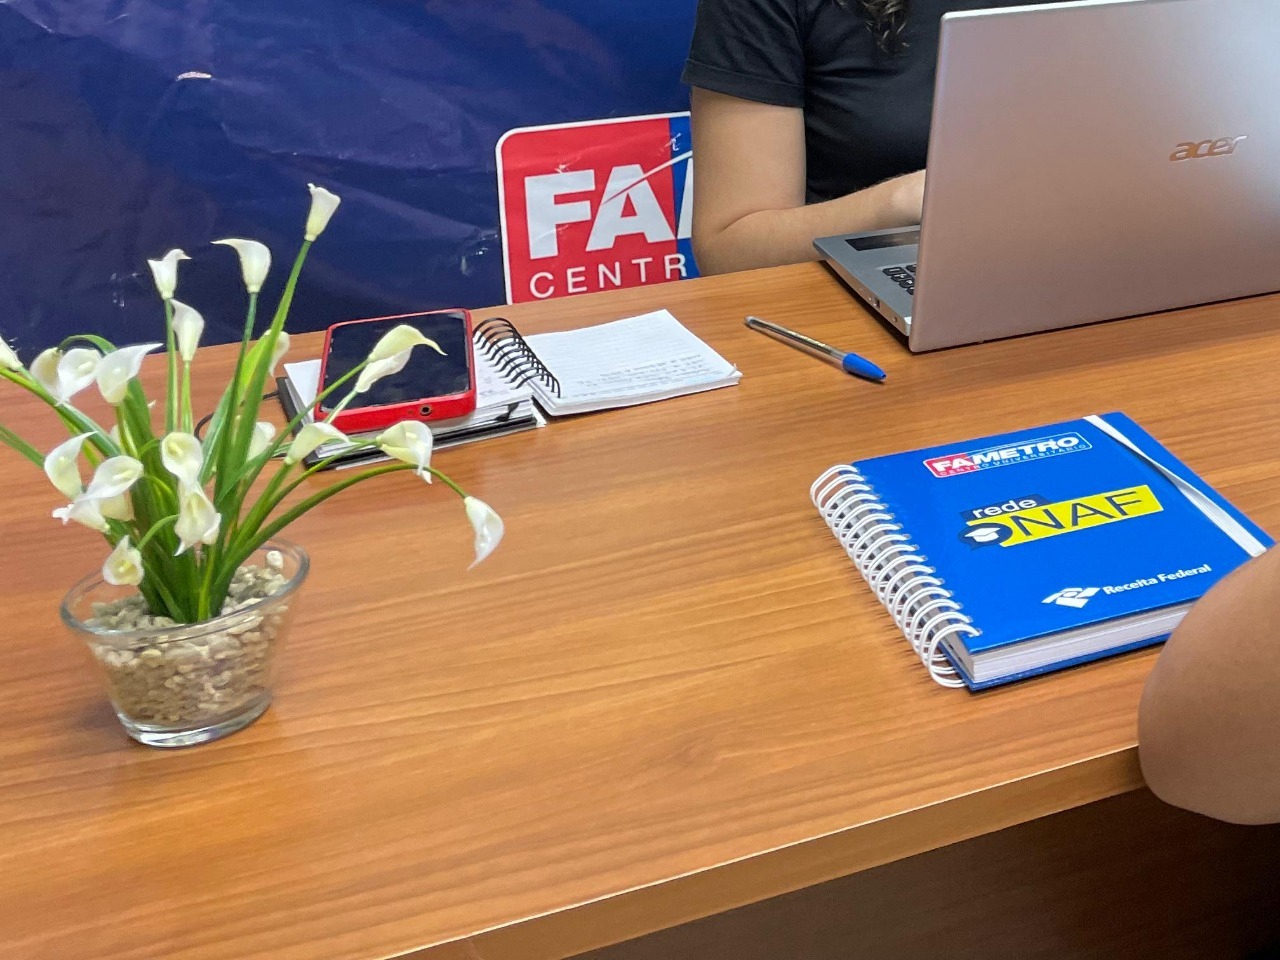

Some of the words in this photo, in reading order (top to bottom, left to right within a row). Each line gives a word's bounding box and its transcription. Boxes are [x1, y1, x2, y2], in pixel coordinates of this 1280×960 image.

[1169, 135, 1247, 162] acer
[524, 158, 693, 260] FA
[932, 437, 1080, 473] FAMETRO
[972, 499, 1038, 519] rede
[1103, 578, 1159, 595] Receita
[1156, 563, 1213, 583] Federal
